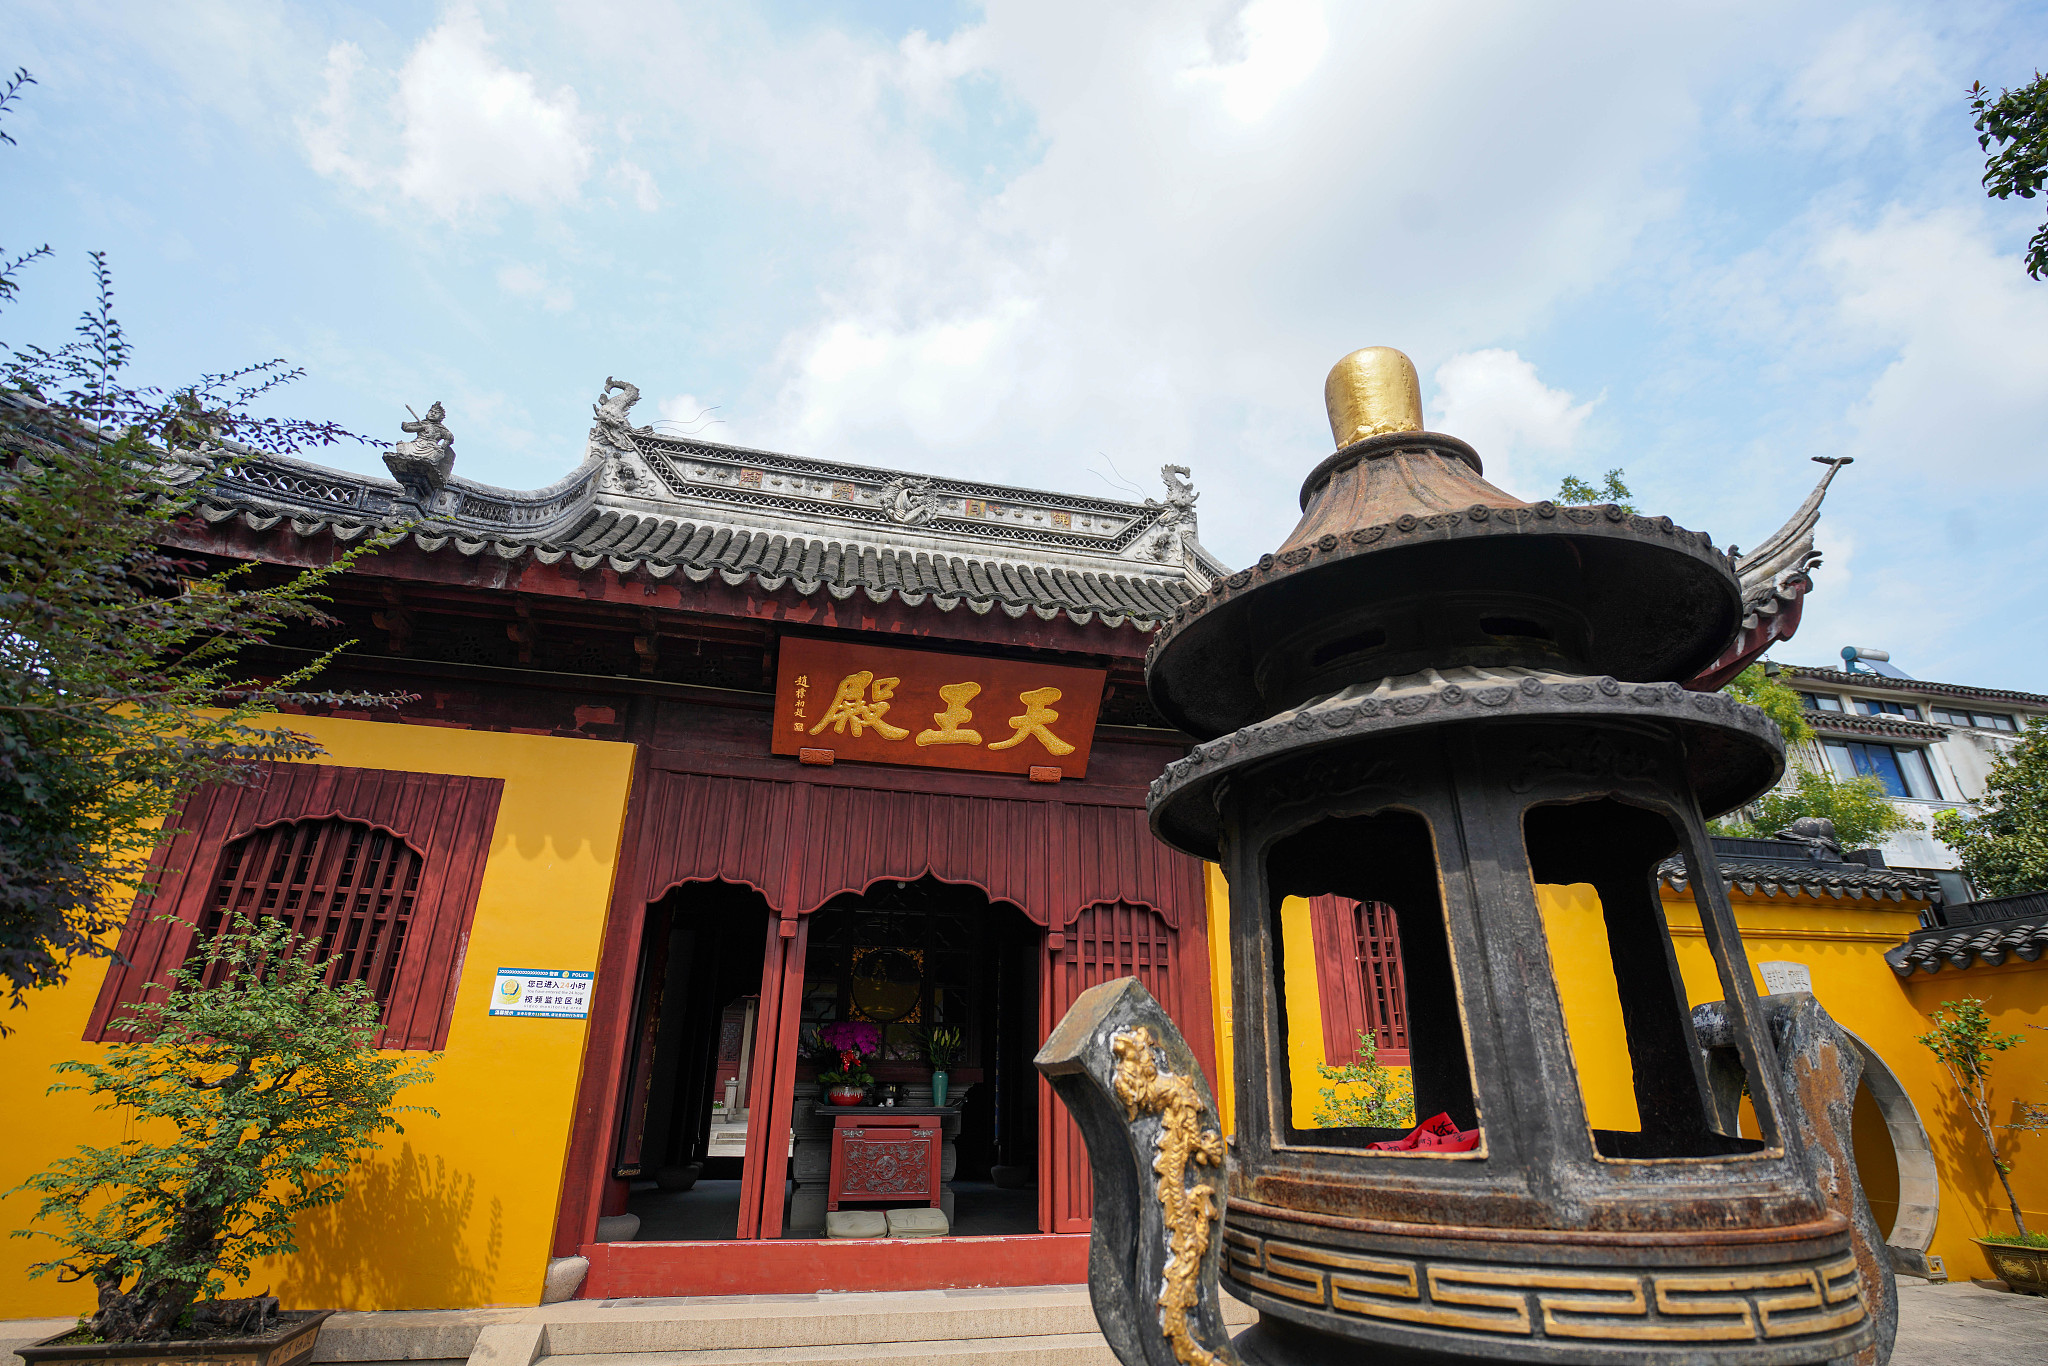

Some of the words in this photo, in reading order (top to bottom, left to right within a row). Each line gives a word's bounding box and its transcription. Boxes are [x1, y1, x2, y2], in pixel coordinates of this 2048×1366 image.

[809, 670, 1075, 756] 天王殿
[528, 980, 586, 990] 您已进入24小时
[525, 995, 583, 1005] 视频监控区域
